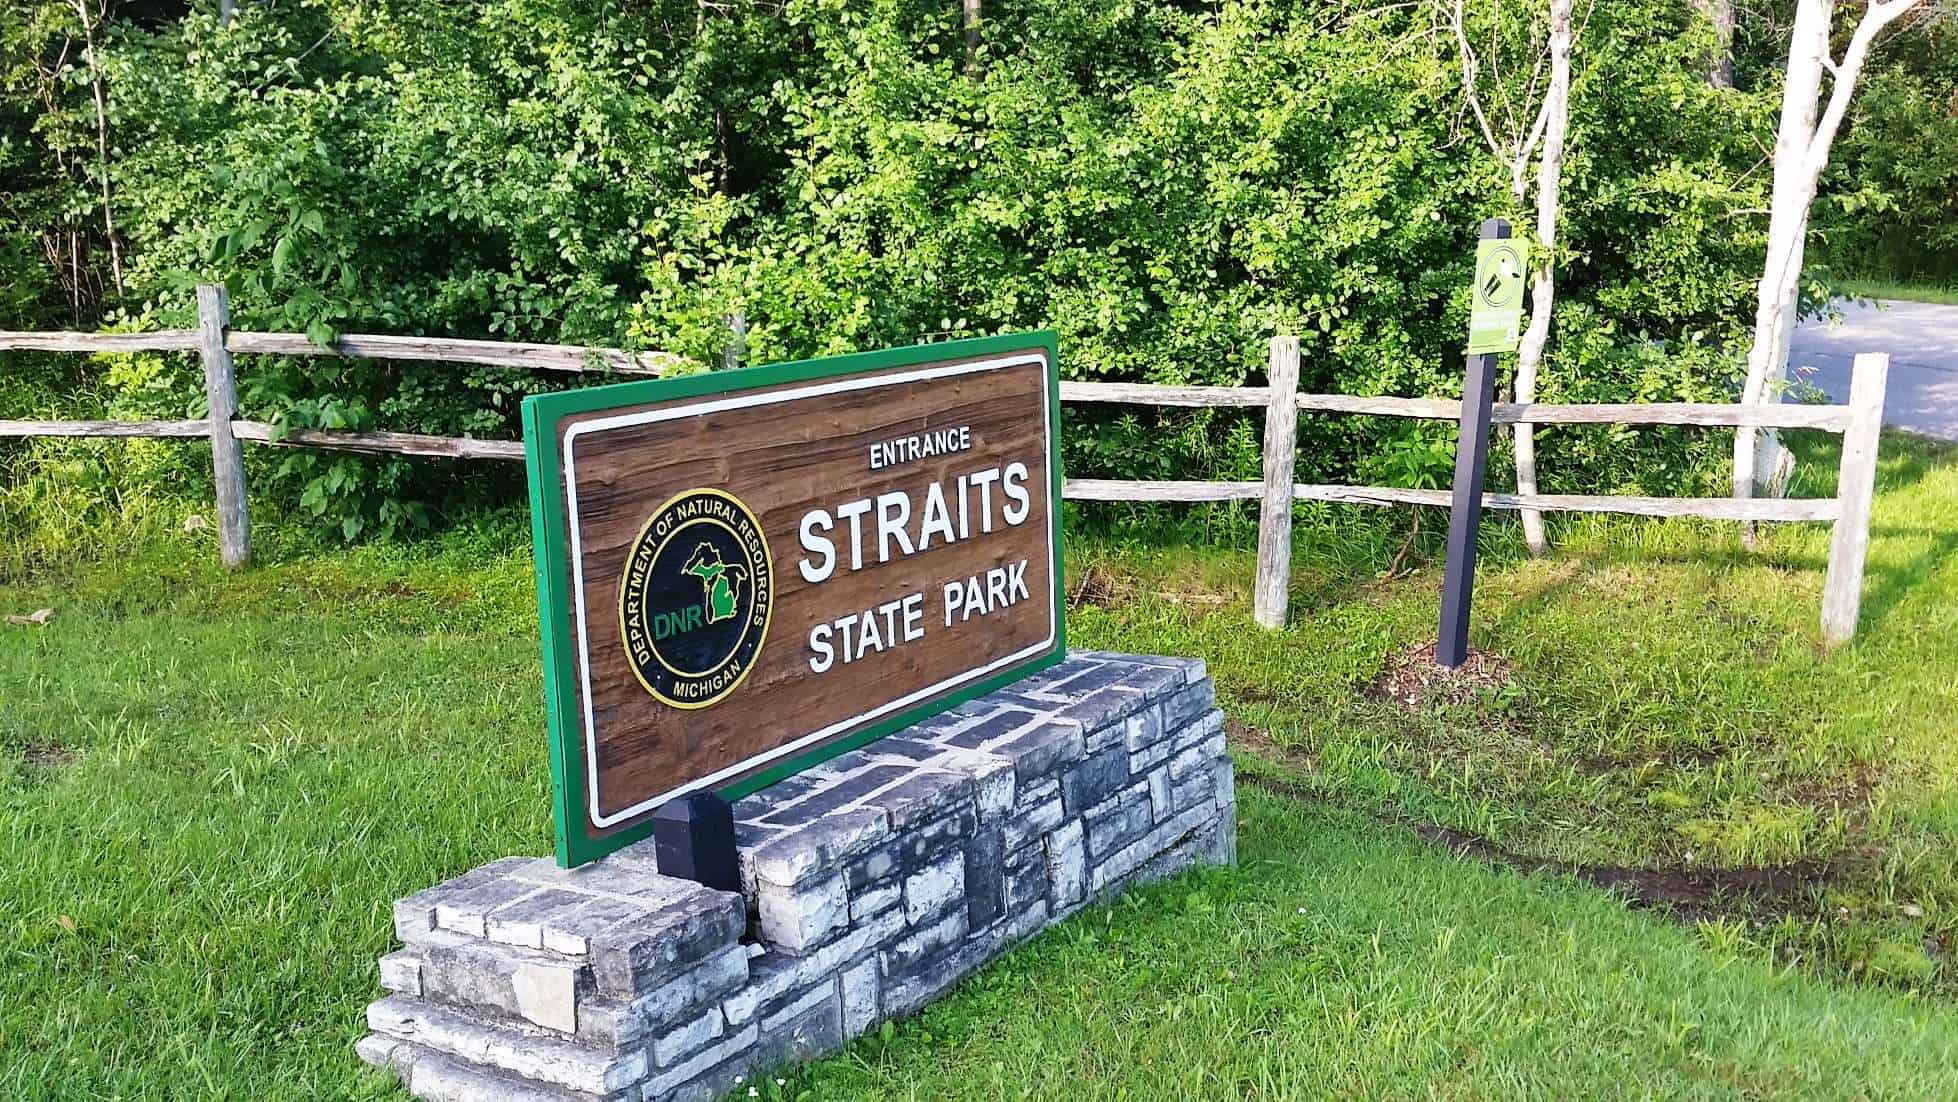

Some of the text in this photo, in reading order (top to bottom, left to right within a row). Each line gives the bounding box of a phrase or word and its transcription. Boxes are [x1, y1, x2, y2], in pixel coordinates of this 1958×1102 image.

[870, 426, 971, 469] ENTRANCE
[798, 462, 1030, 583] STRAITS
[627, 499, 767, 666] DEPARTMENT OF NATURAL RESOURCES
[809, 559, 1030, 673] STATE PARK
[655, 604, 703, 640] DNR
[673, 660, 741, 697] MICHIGAN
